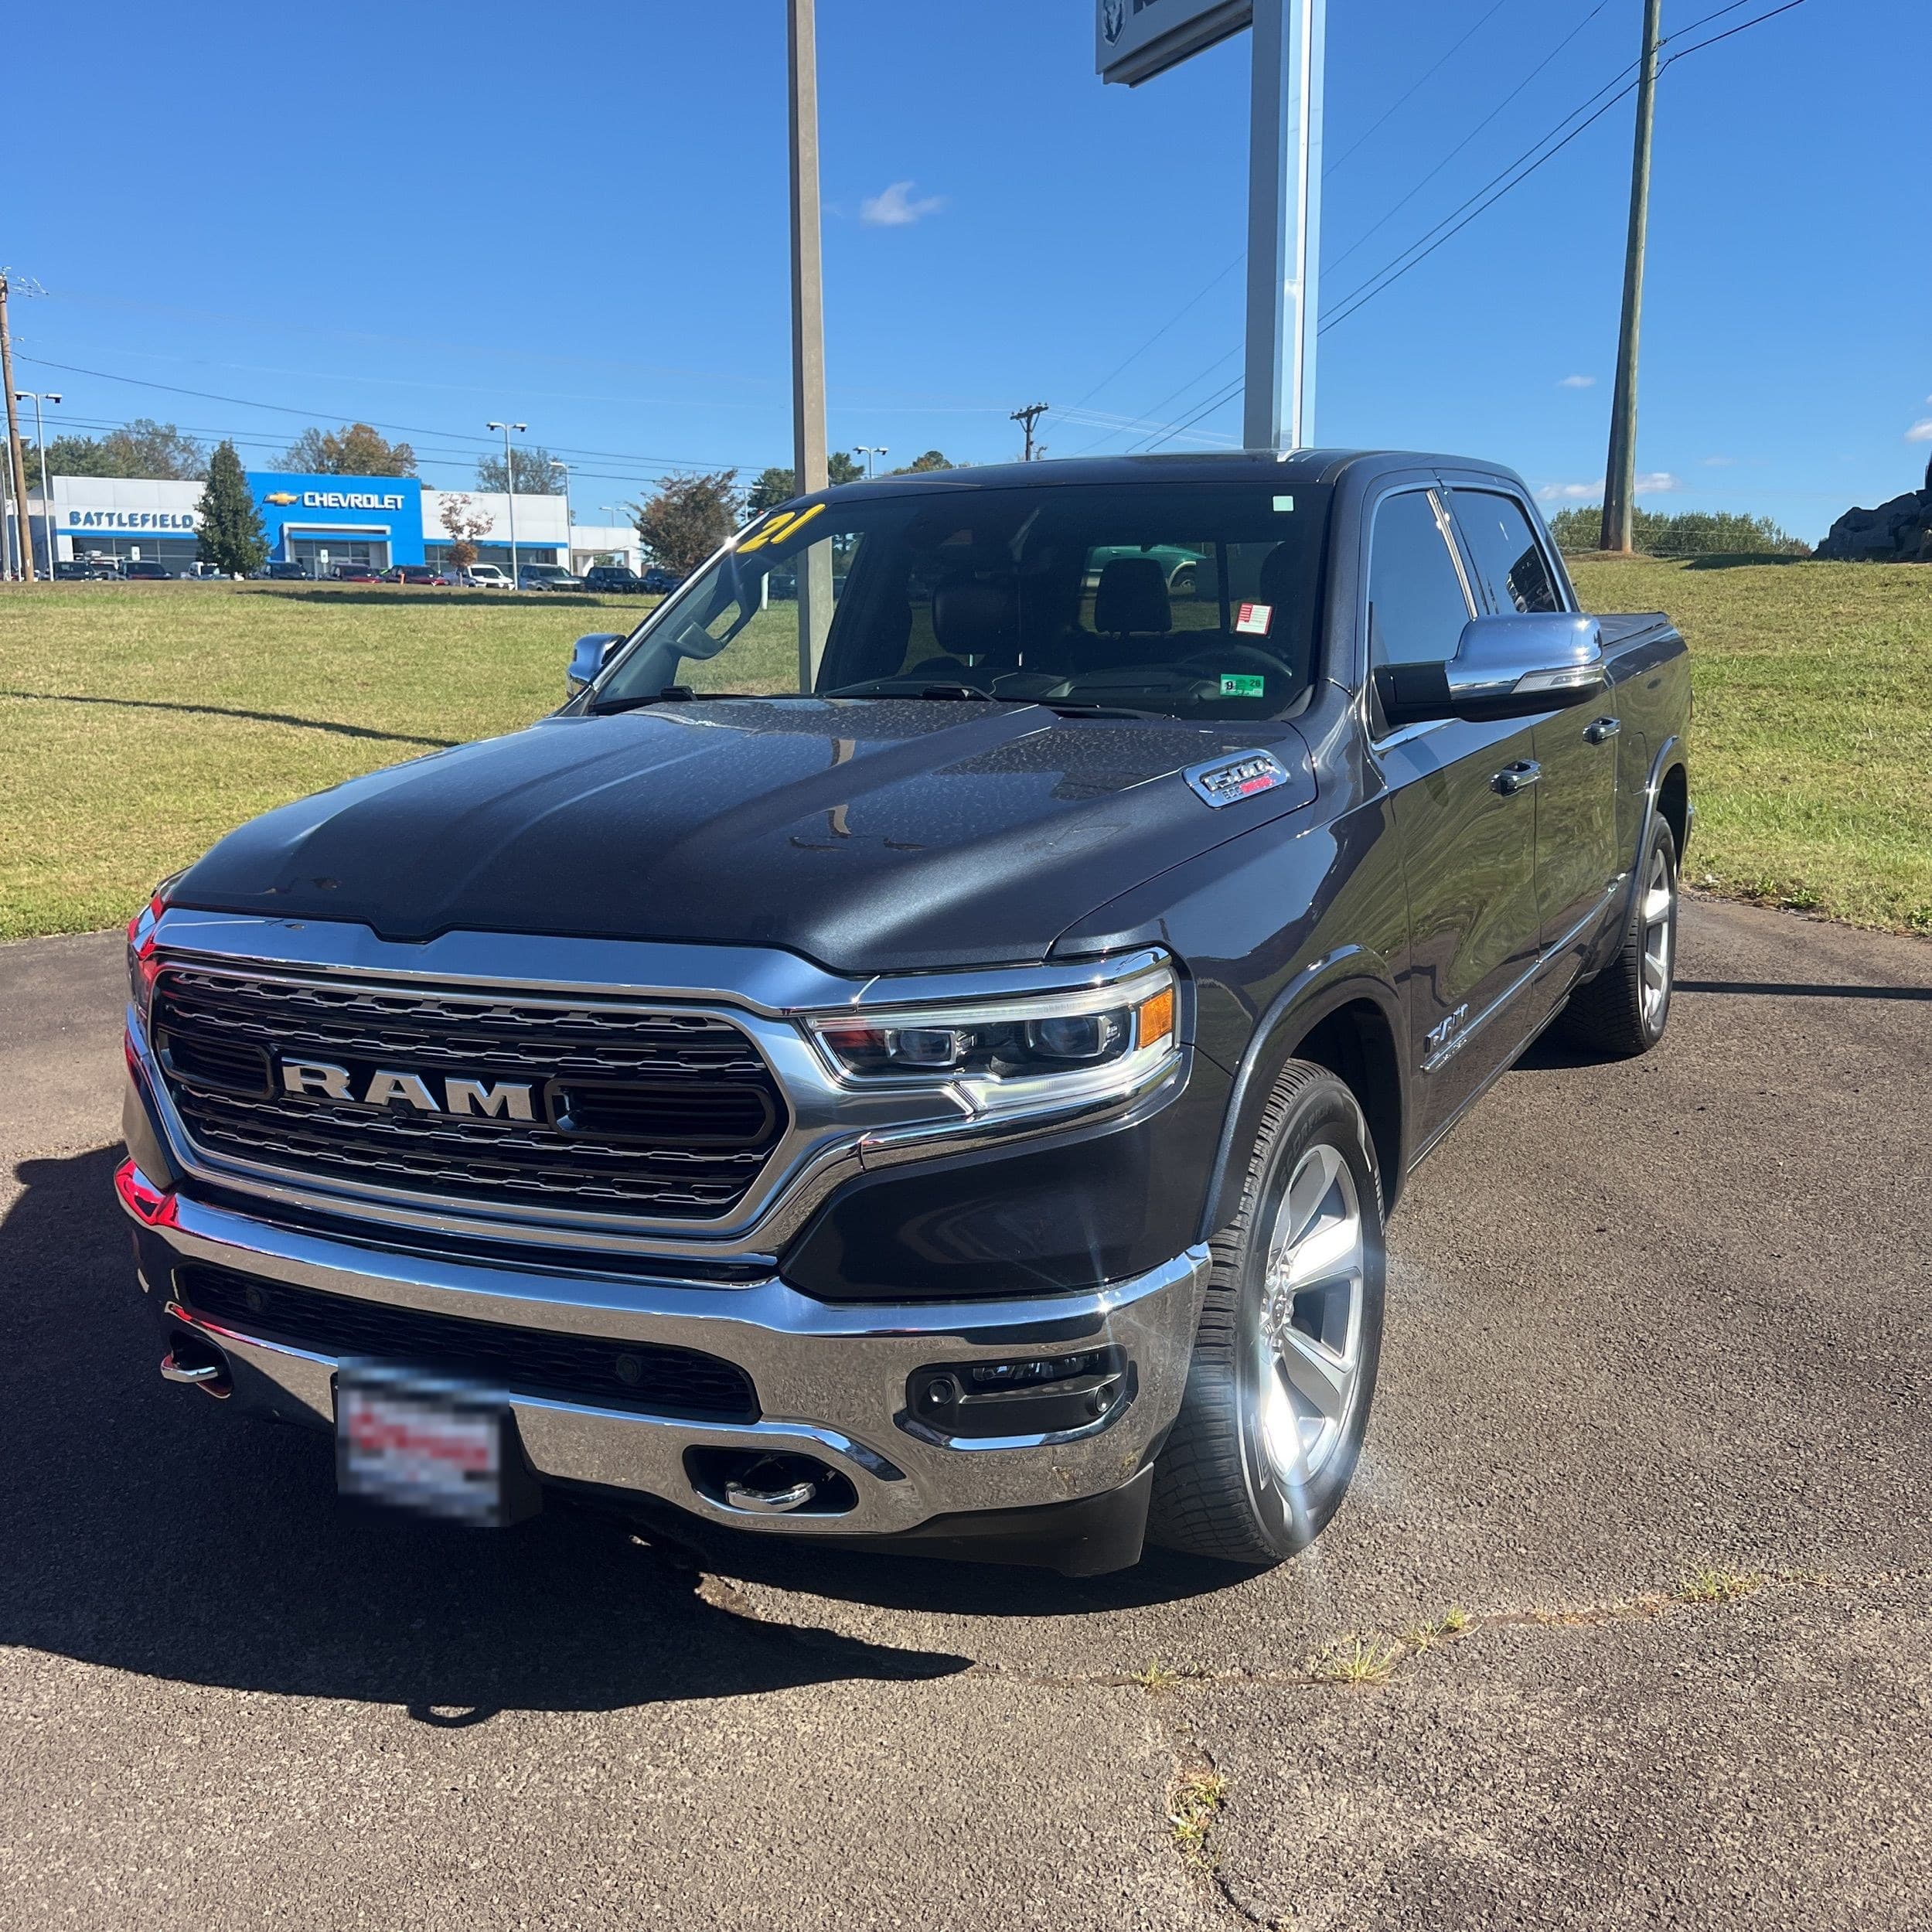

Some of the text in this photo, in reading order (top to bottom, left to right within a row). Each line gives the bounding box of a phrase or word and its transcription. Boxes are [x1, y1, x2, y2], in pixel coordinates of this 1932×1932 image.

[302, 491, 405, 510] CHEVROLET
[69, 511, 194, 529] BATTLEFIELD
[736, 503, 826, 554] 21
[281, 1057, 537, 1121] RAM
